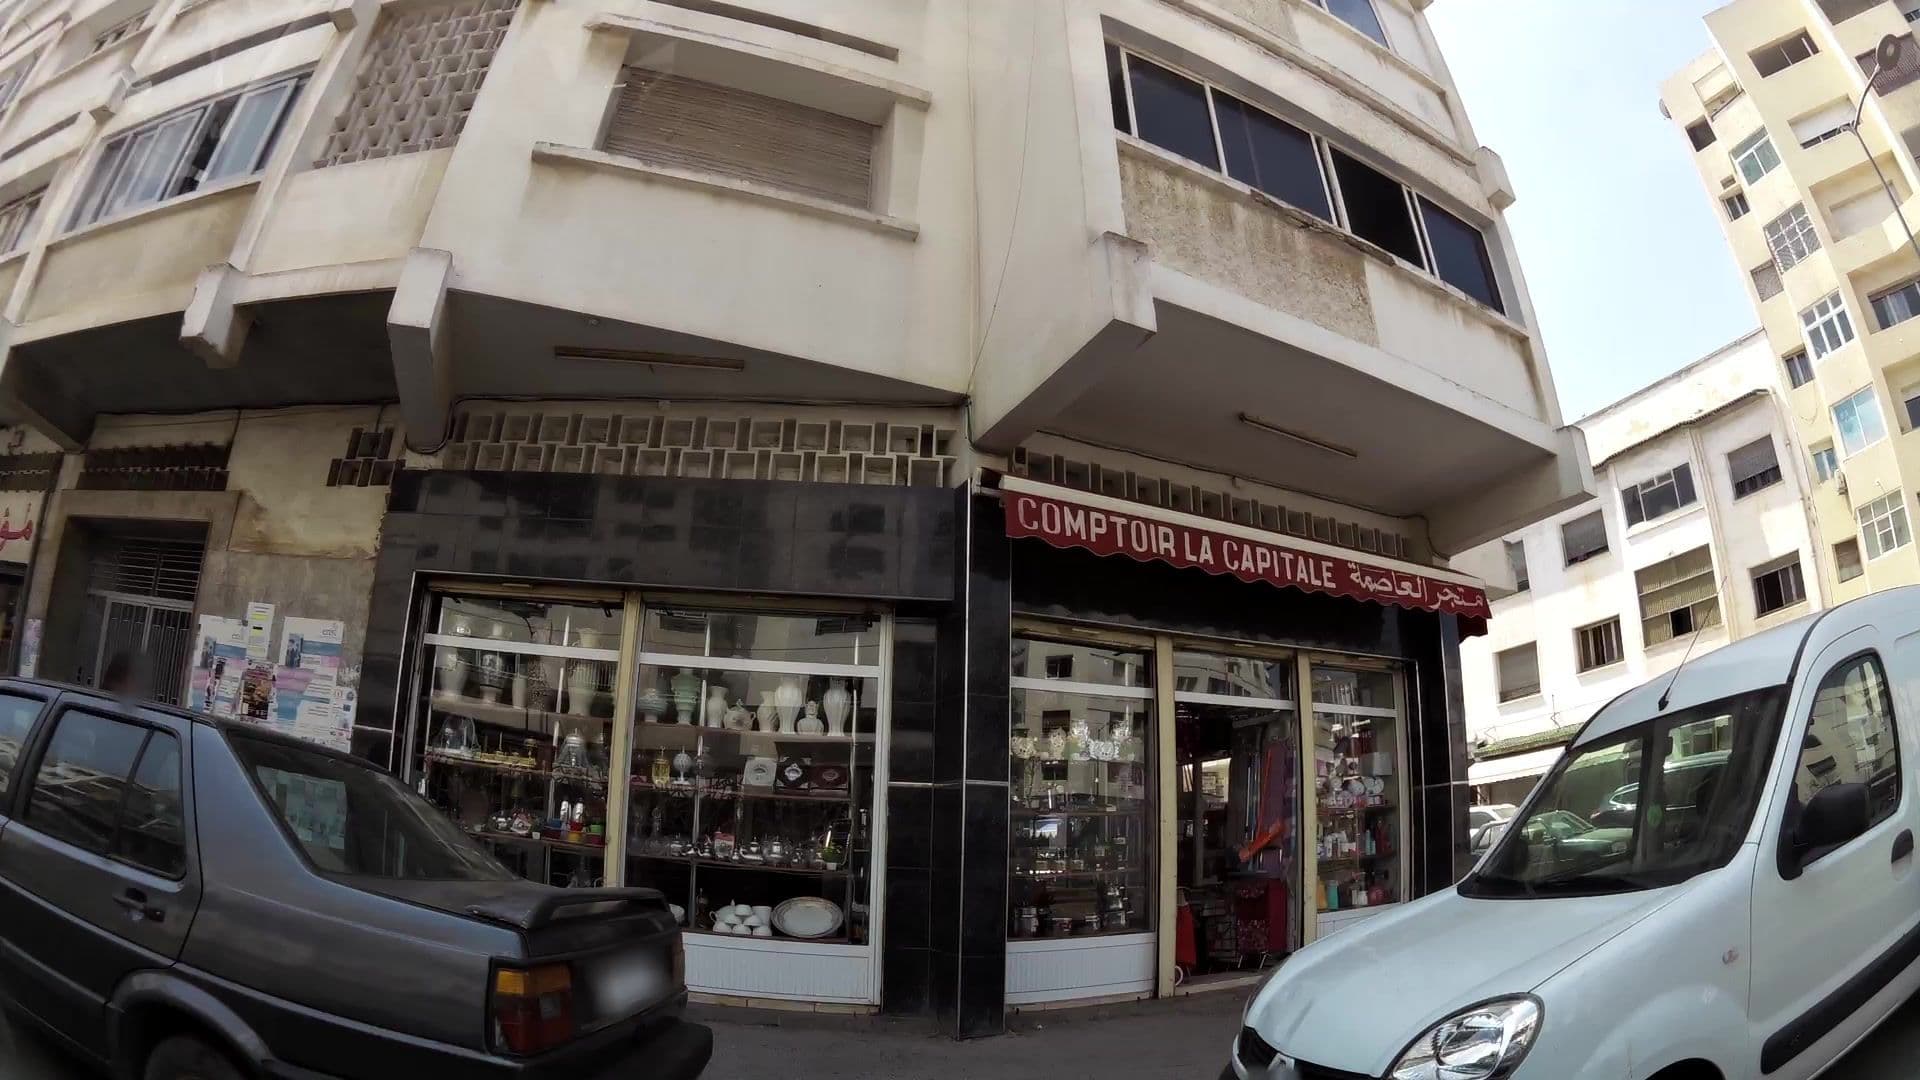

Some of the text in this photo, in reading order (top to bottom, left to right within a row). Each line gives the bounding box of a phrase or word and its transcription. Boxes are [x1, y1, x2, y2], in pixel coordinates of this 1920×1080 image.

[1017, 497, 1336, 588] COMPTOIR LA CAPITALE
[1347, 562, 1484, 610] متجر العاصمة
